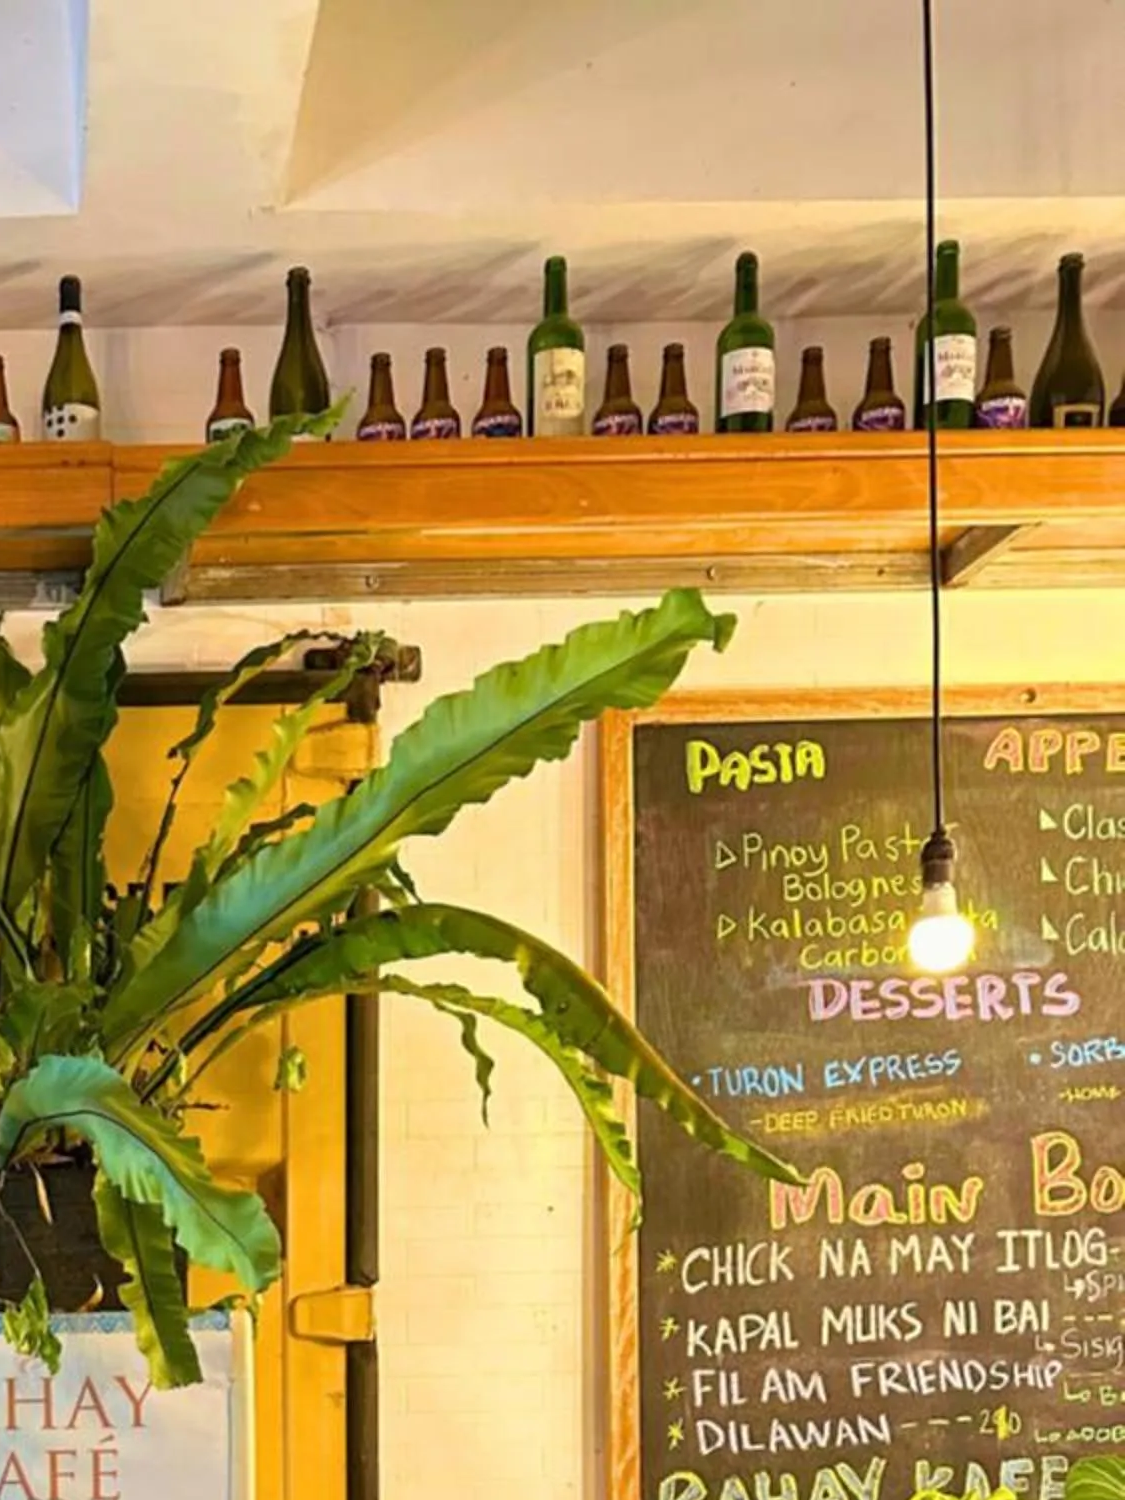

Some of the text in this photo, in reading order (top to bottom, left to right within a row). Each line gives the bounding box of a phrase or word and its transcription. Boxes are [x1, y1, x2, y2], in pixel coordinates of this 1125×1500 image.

[686, 740, 825, 793] PASTA
[742, 822, 931, 877] Pinoy Past
[783, 872, 923, 907] Bolognes
[747, 904, 906, 941] Kalabasa
[807, 972, 1081, 1022] DESSERTS
[708, 1048, 963, 1097] TURON EXPRESS
[899, 1098, 968, 1119] TURON
[682, 1241, 795, 1295] CHICK
[818, 1237, 872, 1280] NA
[890, 1232, 976, 1278] MAY
[686, 1299, 1051, 1358] KAPAL MUKS NI BAI
[692, 1360, 1064, 1407] FIL AM FRIENDSHIP
[695, 1412, 892, 1456] DILAWAN
